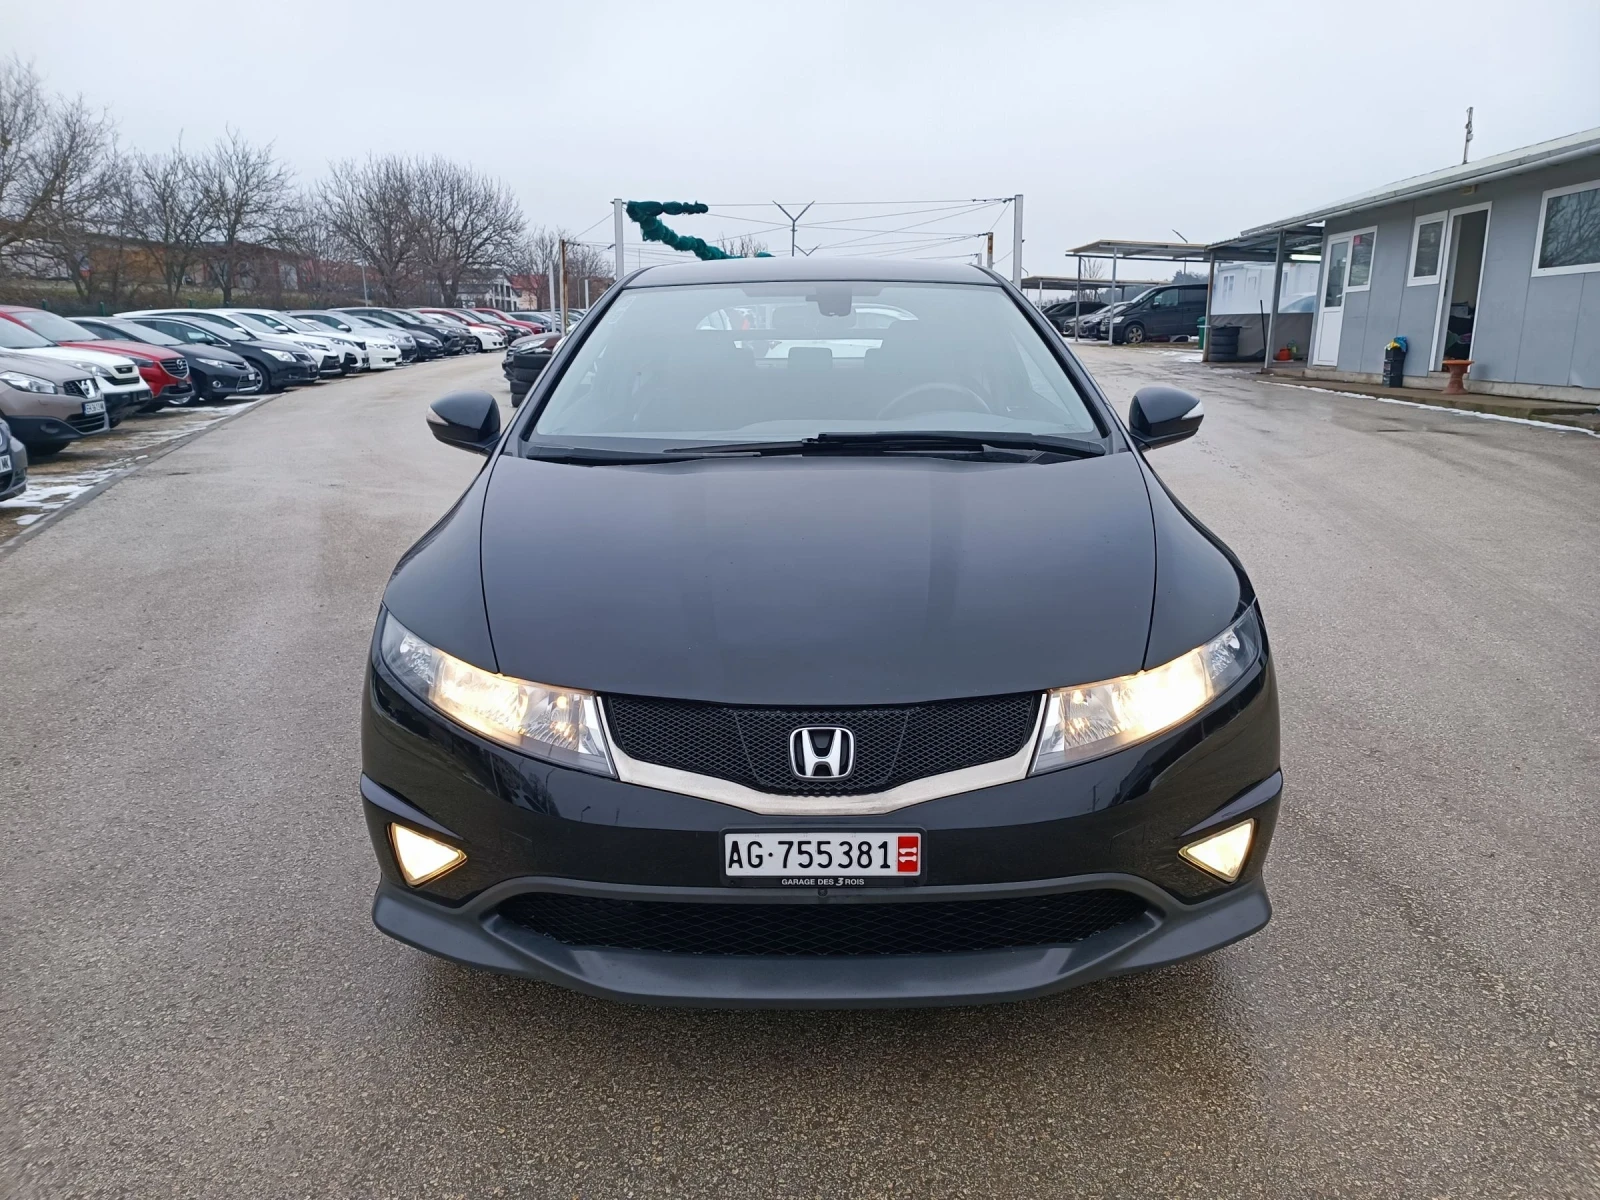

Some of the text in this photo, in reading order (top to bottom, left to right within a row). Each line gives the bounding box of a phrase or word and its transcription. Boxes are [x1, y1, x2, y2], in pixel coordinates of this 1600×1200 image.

[781, 877, 865, 887] GARAGE DES 3 ROIS
